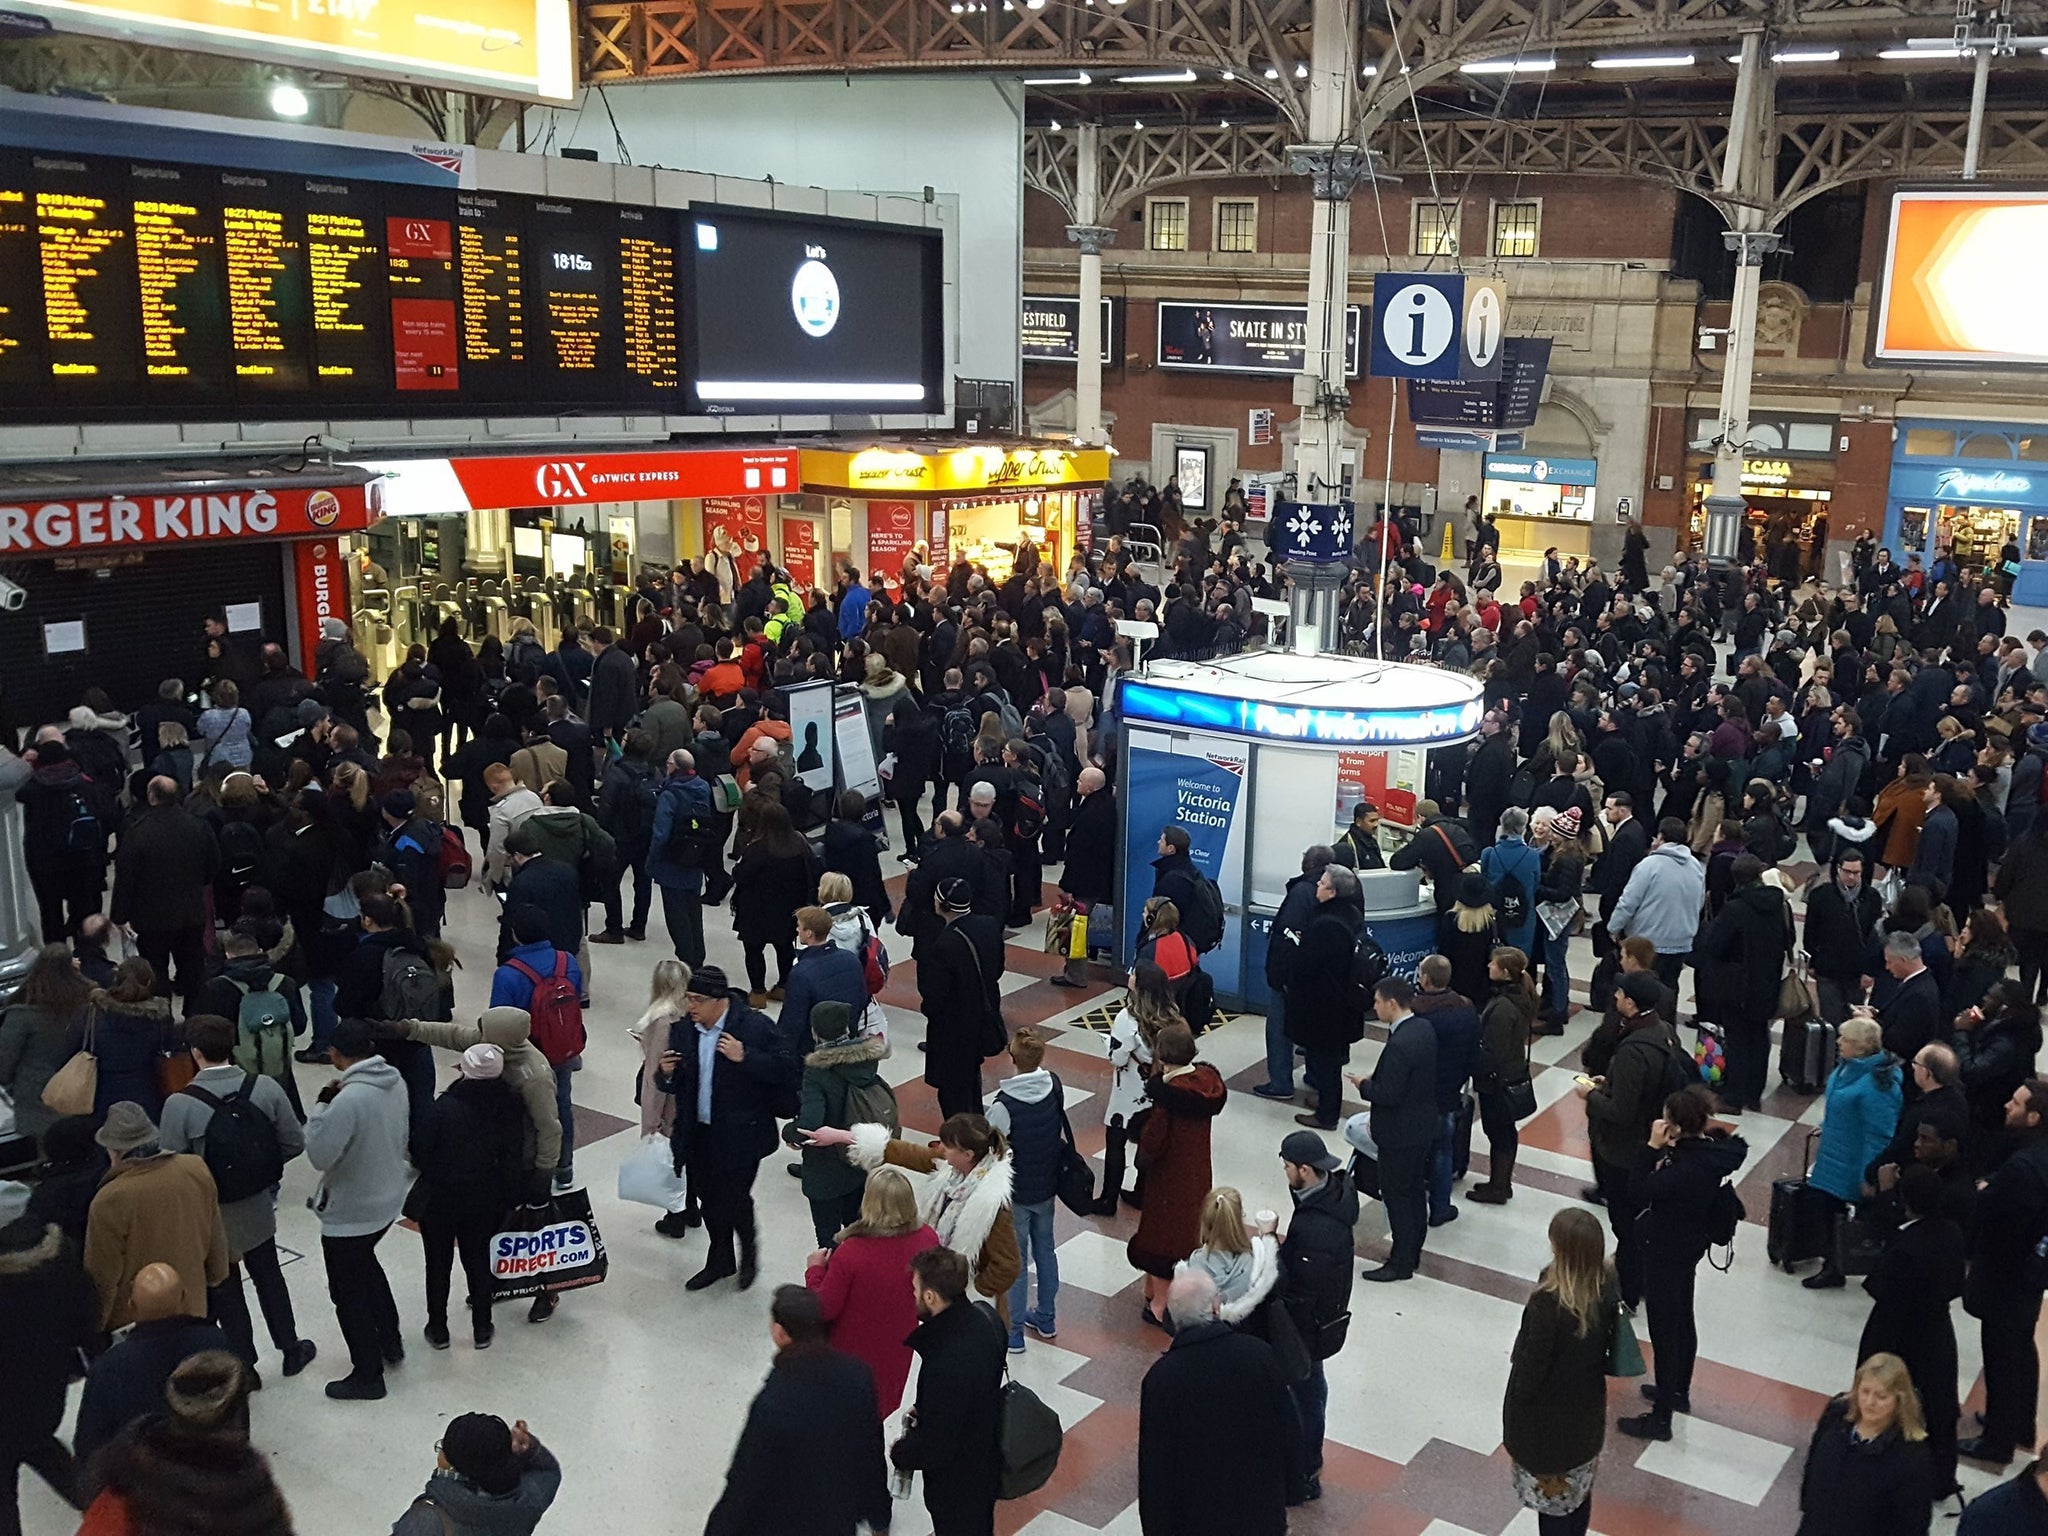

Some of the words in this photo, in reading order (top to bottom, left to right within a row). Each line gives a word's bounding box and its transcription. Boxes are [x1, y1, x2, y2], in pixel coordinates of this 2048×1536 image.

[405, 222, 432, 242] GX
[1023, 312, 1066, 328] ESTFIELD
[1511, 315, 1548, 331] PARCEL
[1552, 316, 1586, 332] OFFICE
[1229, 320, 1268, 338] SKATE
[1271, 322, 1284, 340] IN
[1287, 322, 1308, 340] STY
[1548, 468, 1592, 476] EXCHANGE
[1742, 460, 1750, 472] I
[1750, 460, 1790, 476] CASA
[536, 462, 588, 498] GX
[591, 472, 636, 484] GATWICK
[639, 470, 680, 482] EXPRESS
[309, 498, 336, 510] BURGER
[312, 504, 338, 520] KING
[706, 507, 728, 516] SEASON
[710, 500, 741, 508] SPARKLING
[0, 500, 144, 550] RGER
[153, 492, 278, 538] KING
[871, 532, 892, 540] HERE'S
[894, 532, 904, 540] TO
[878, 539, 912, 547] SPARKLING
[314, 564, 330, 640] BURGER
[1317, 711, 1457, 740] Information
[1206, 752, 1247, 764] NetworkRail
[1346, 756, 1365, 766] from
[1177, 778, 1212, 792] Welcome
[1212, 784, 1220, 793] to
[1178, 789, 1231, 812] Victoria
[862, 808, 879, 822] ctoria
[1176, 806, 1226, 828] Station
[1194, 848, 1210, 858] Clear
[496, 1225, 586, 1258] SPORTS
[496, 1250, 589, 1274] DIRECT.COM
